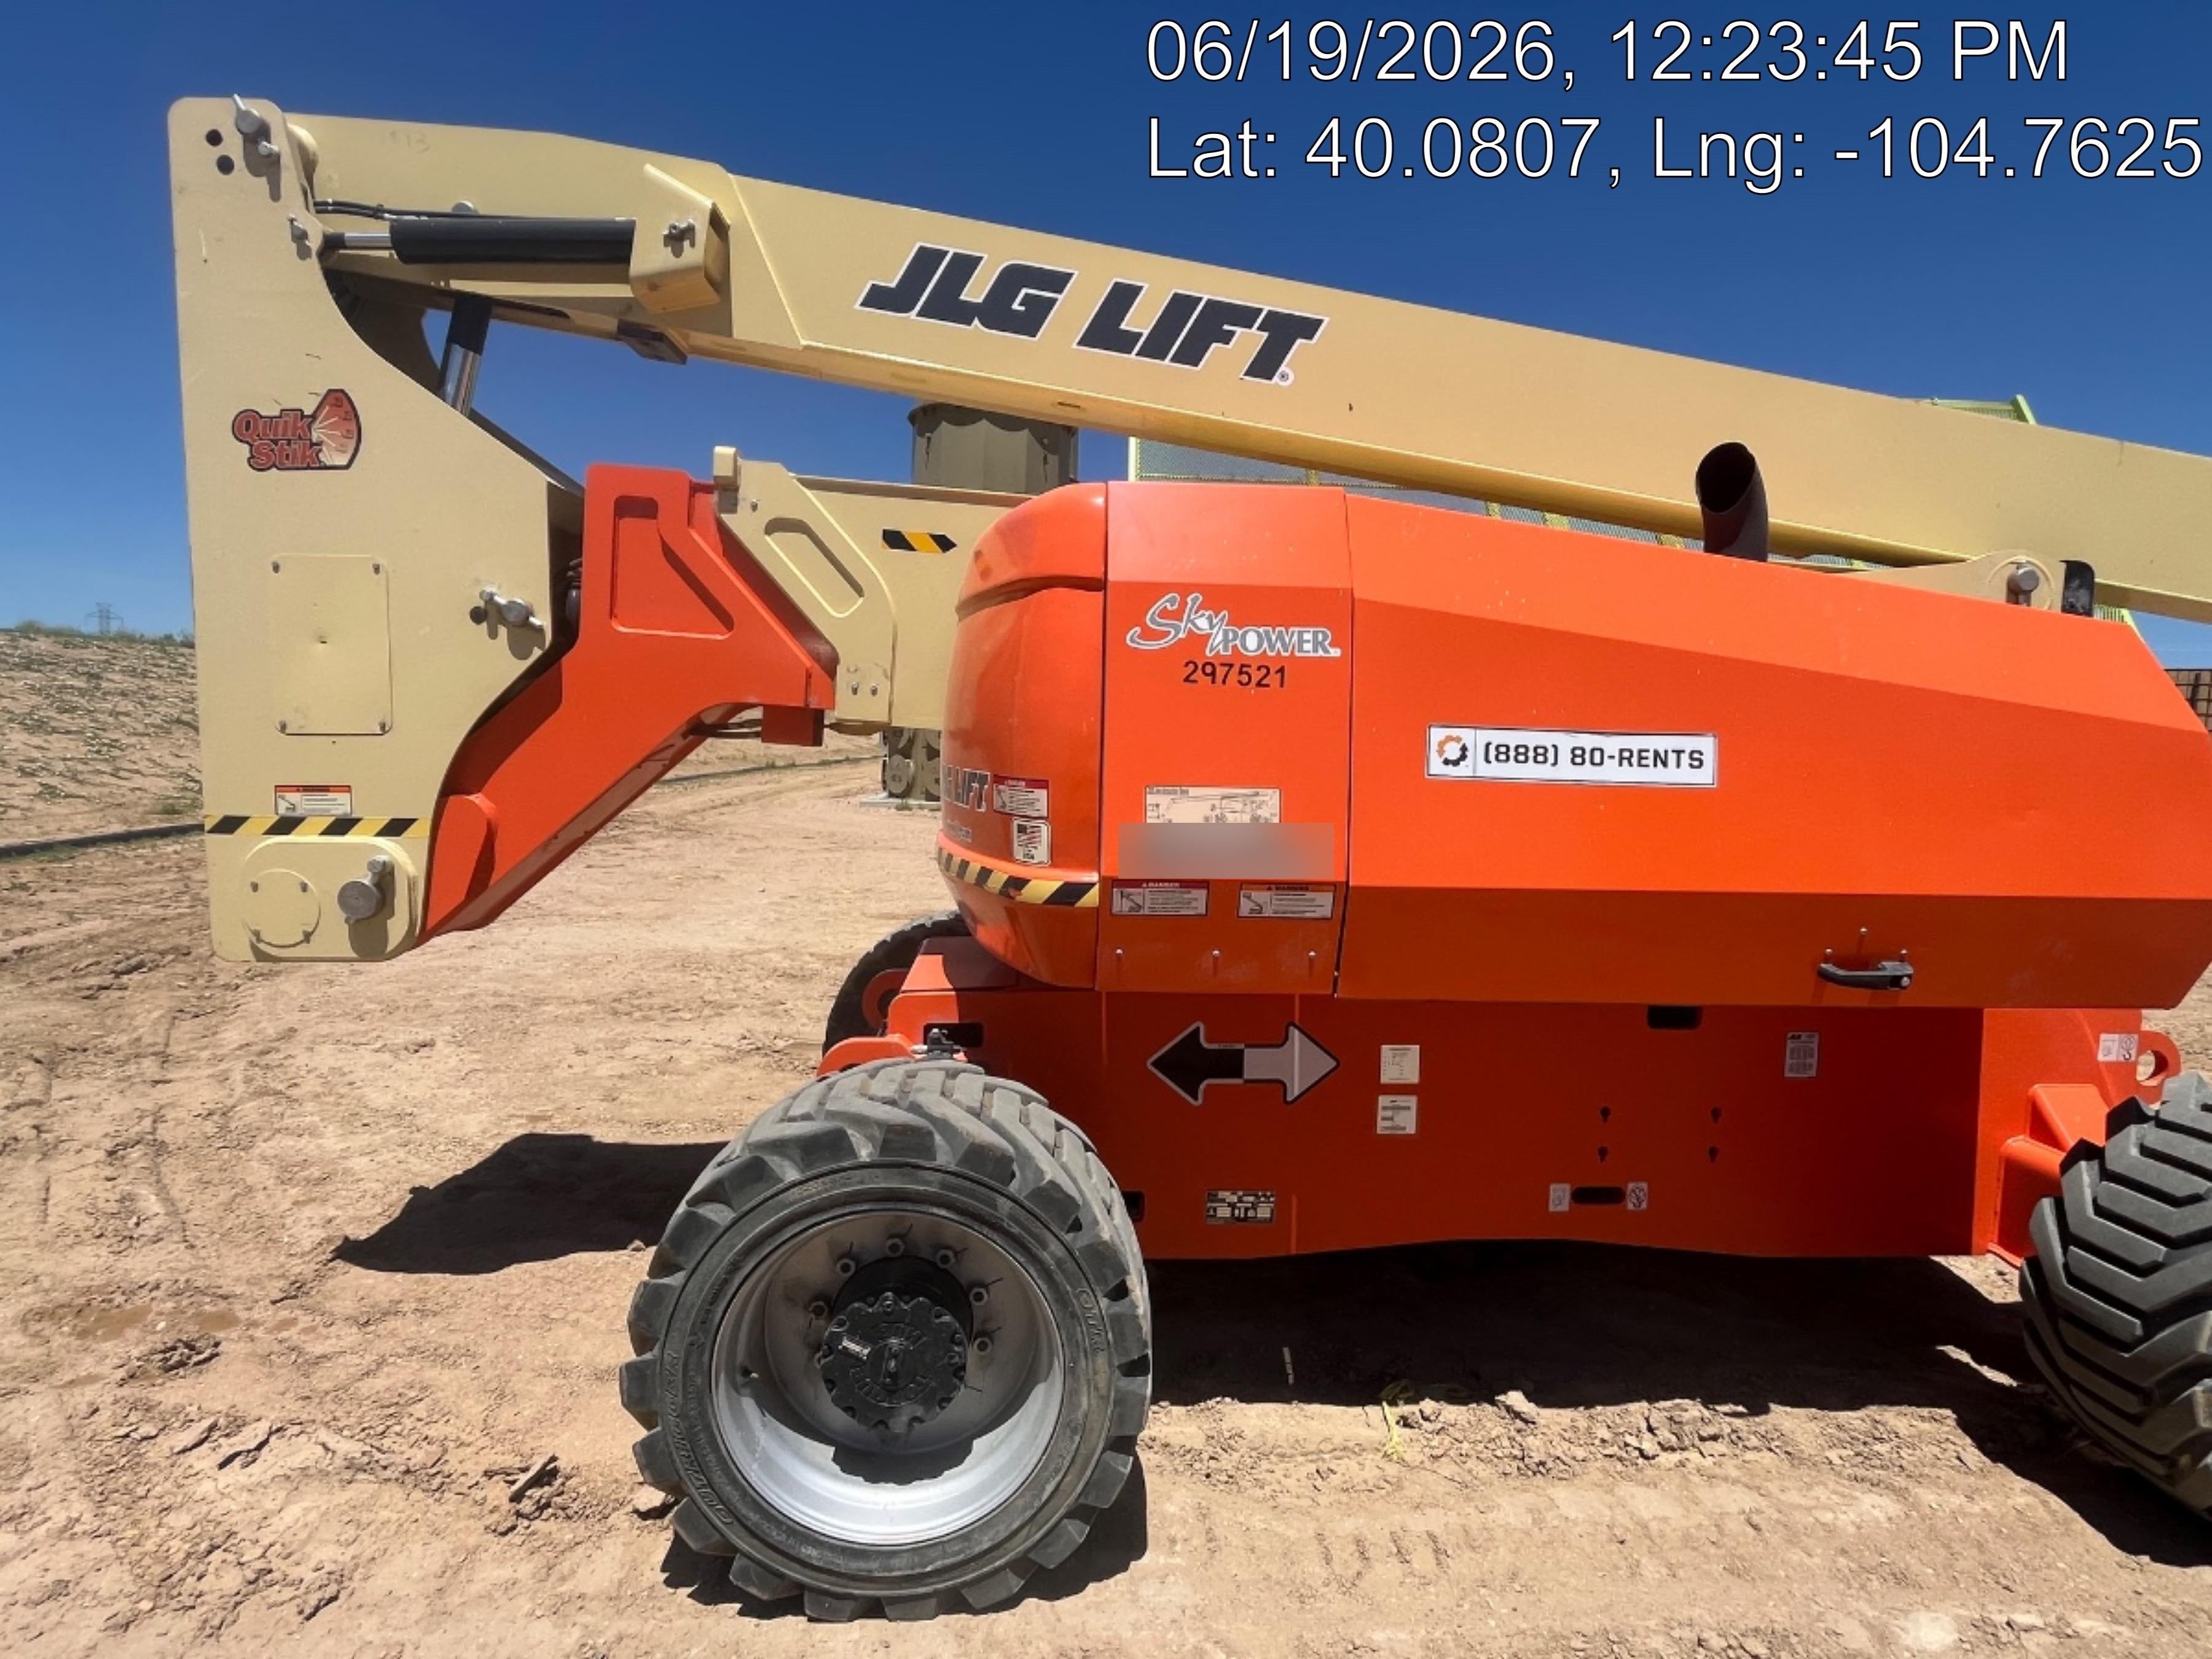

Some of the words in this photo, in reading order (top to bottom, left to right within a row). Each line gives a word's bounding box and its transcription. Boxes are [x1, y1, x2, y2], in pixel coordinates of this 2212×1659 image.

[855, 242, 1078, 340] JLG
[1072, 278, 1330, 383] LIFT
[233, 409, 311, 443] Quik
[249, 439, 320, 469] Stik
[1126, 593, 1229, 656] Sky
[1219, 627, 1335, 656] POWER
[1183, 660, 1286, 688] 297521
[1483, 741, 1559, 767] (888)
[1569, 745, 1705, 769] 80-RENTS
